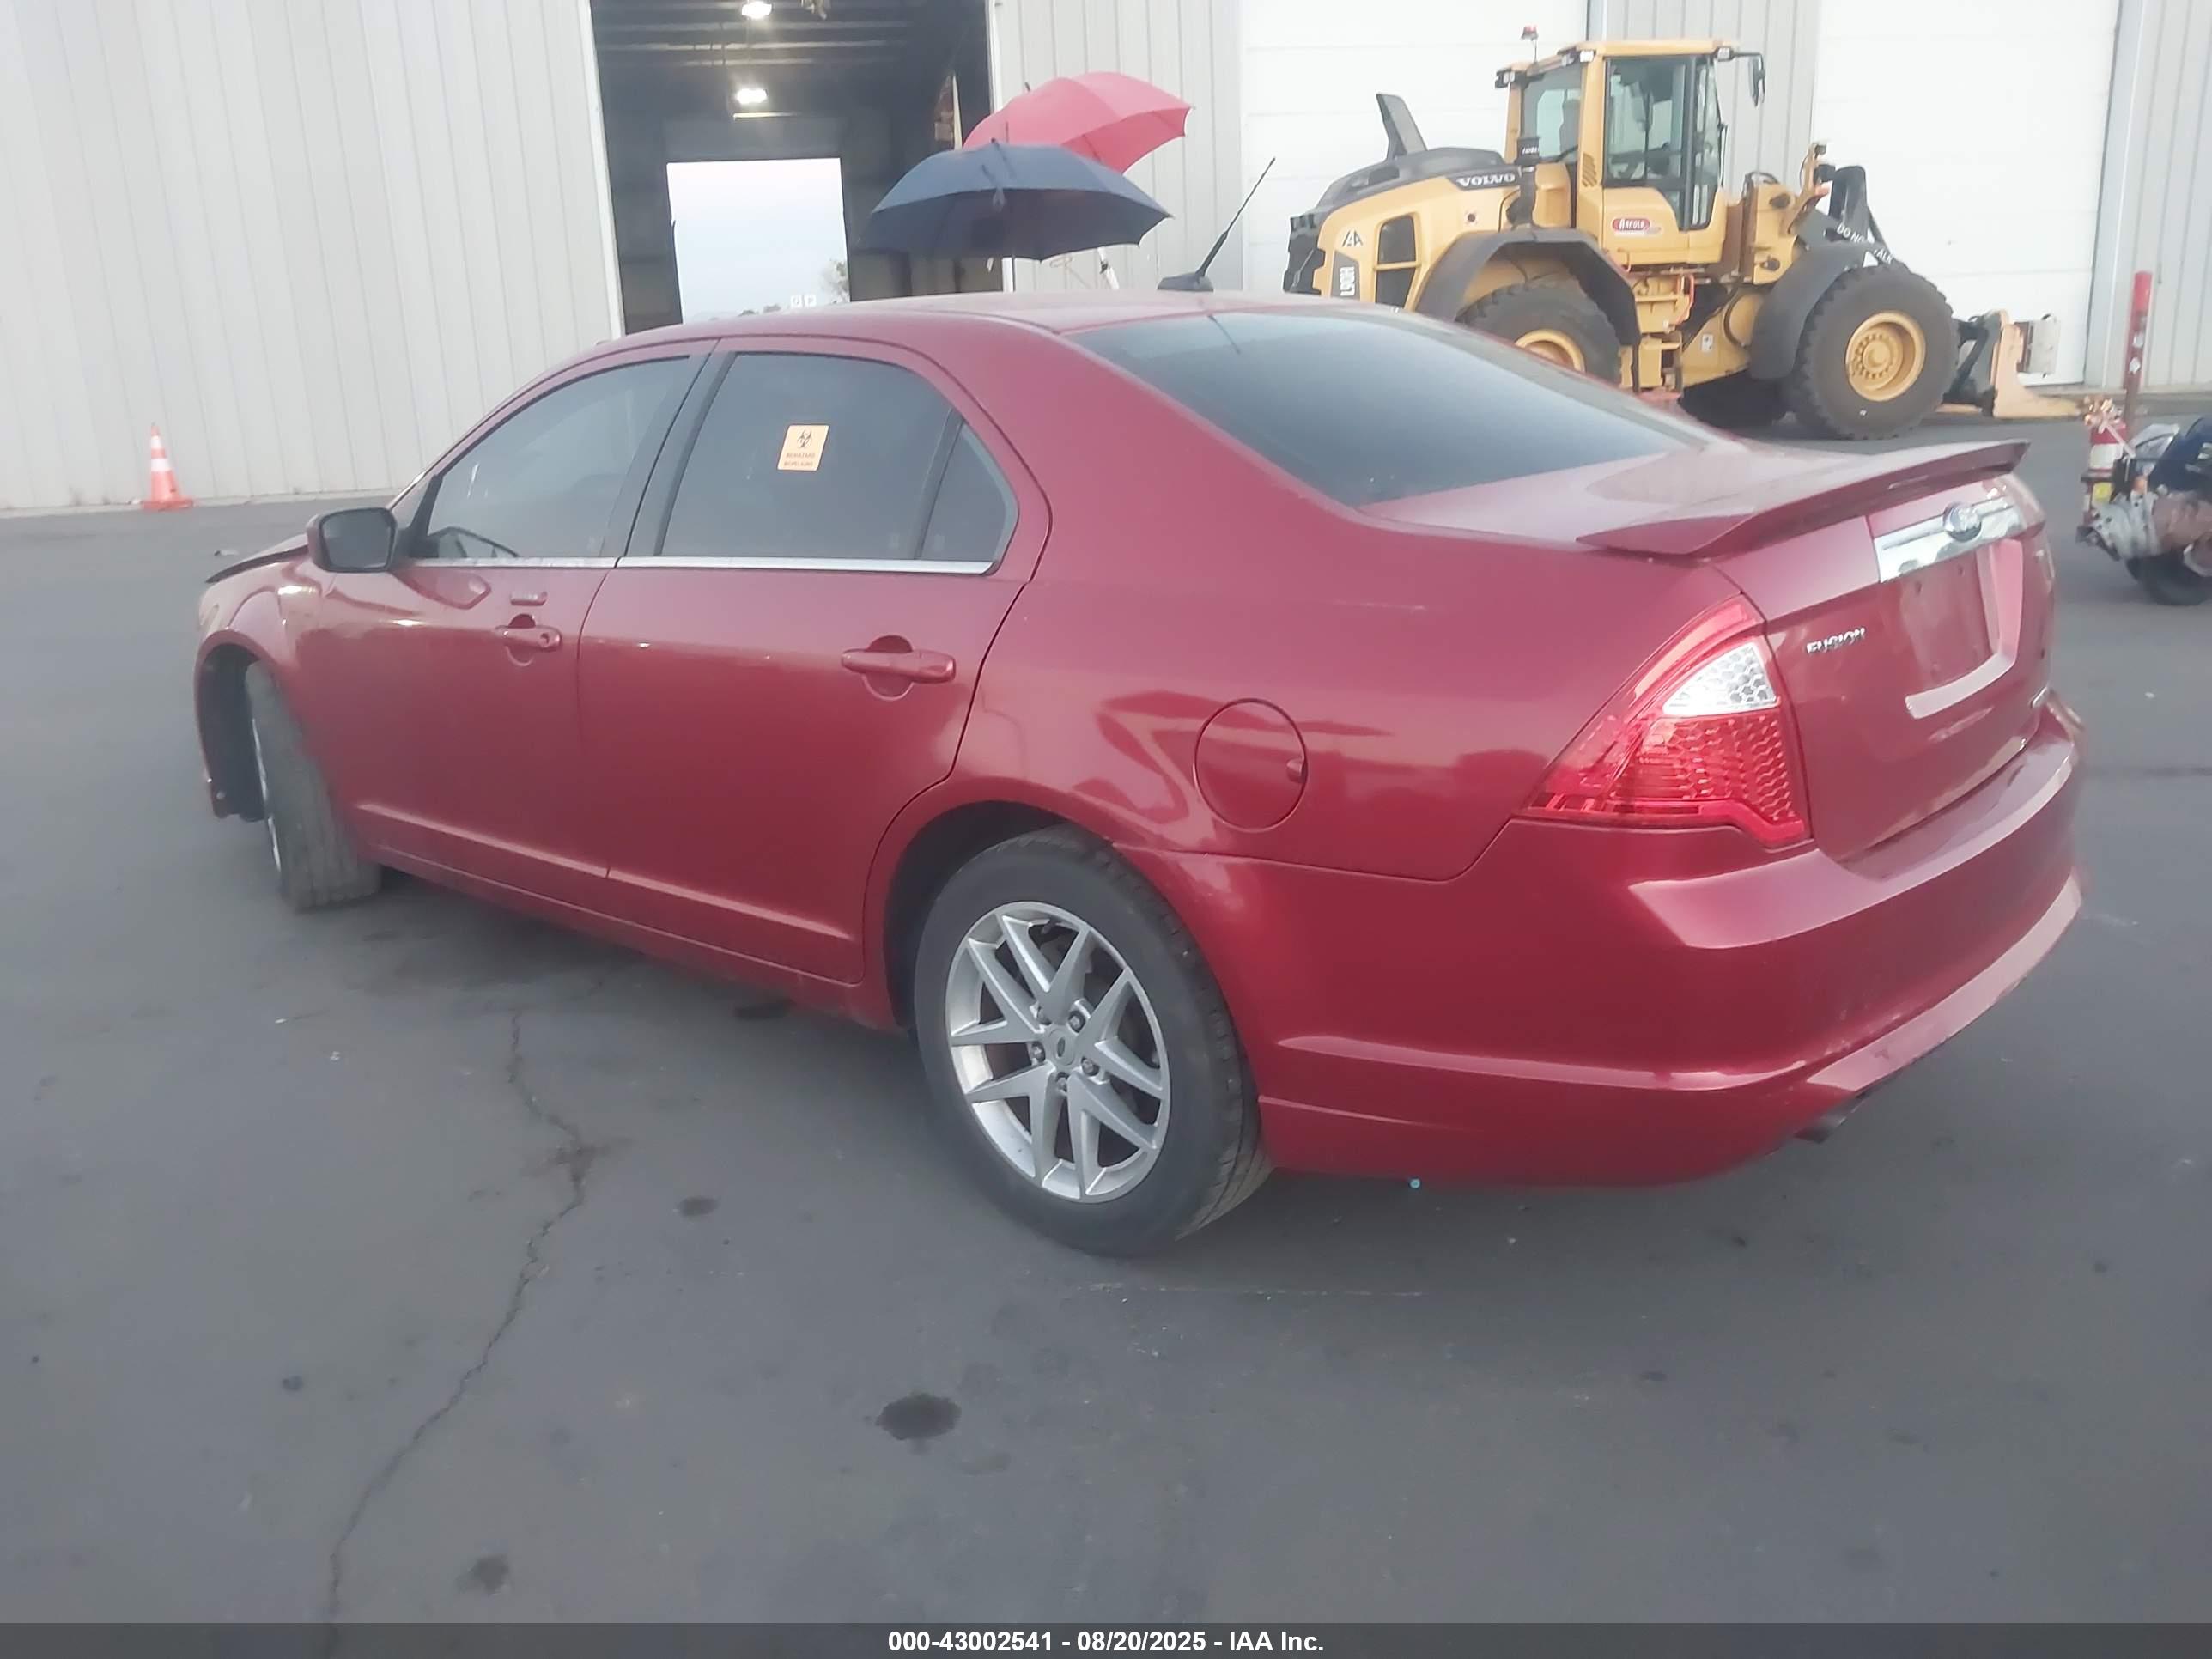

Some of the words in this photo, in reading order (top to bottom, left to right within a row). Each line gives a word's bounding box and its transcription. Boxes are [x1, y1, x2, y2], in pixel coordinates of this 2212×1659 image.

[1456, 173, 1516, 186] VOLVO
[1837, 222, 1851, 238] DO
[1806, 627, 1866, 653] FUSION
